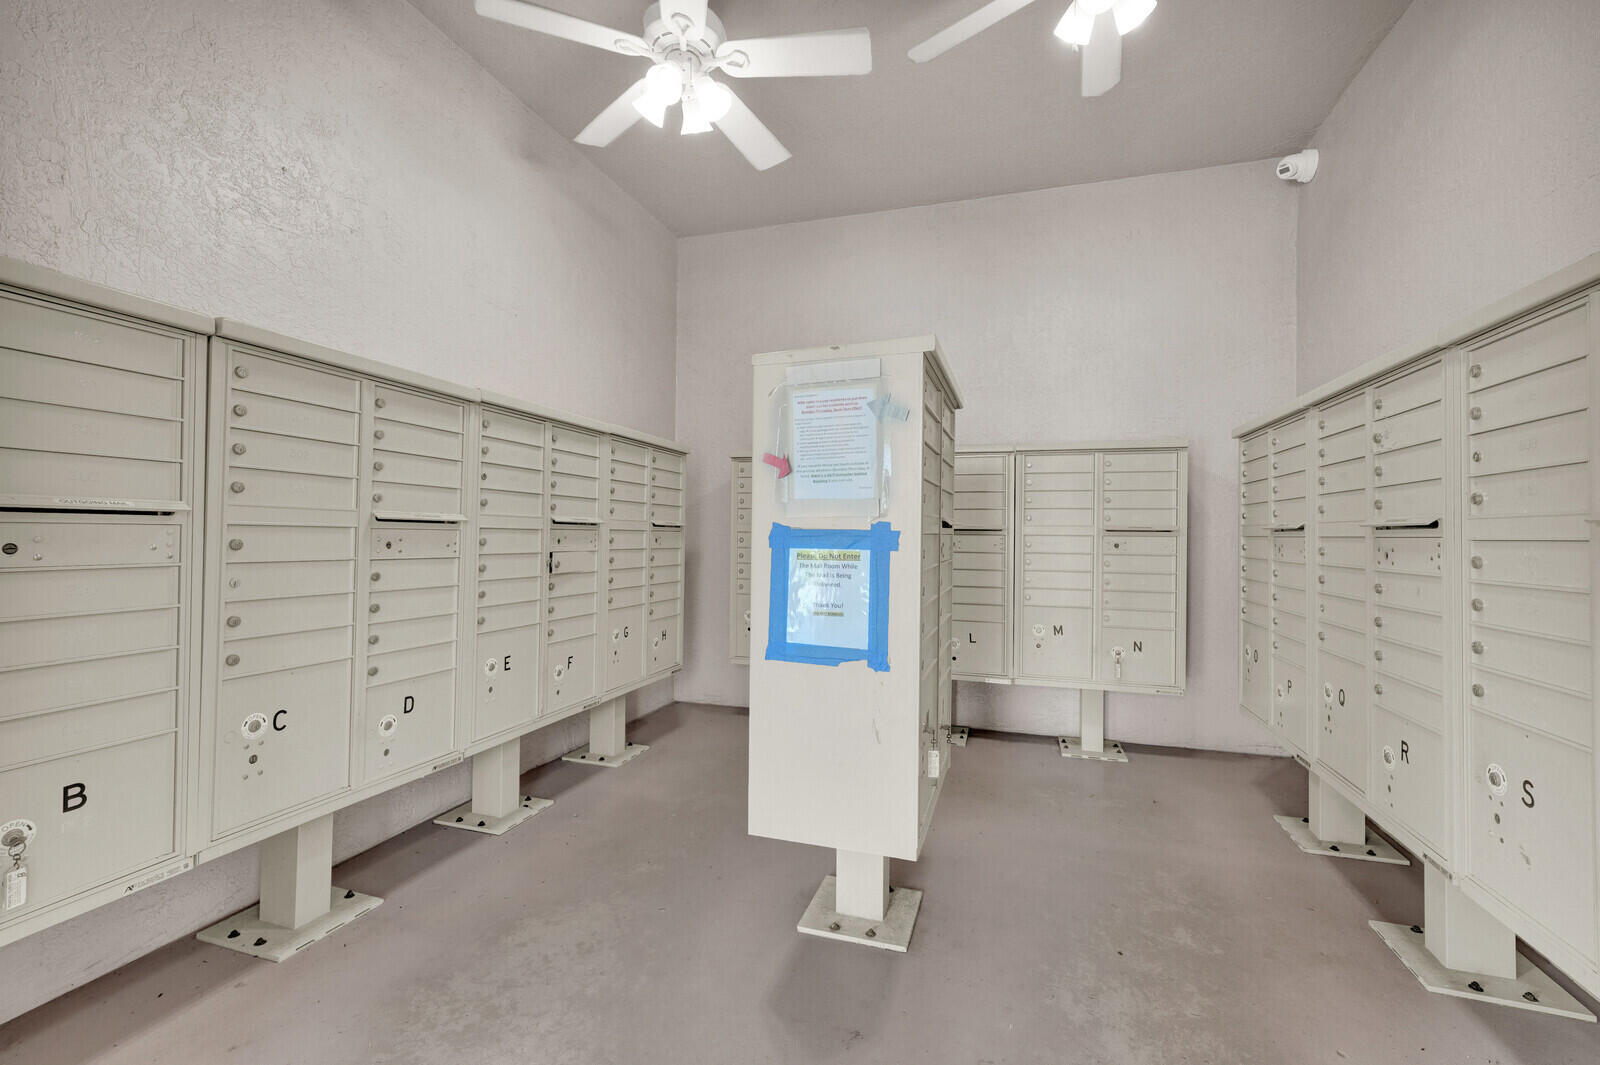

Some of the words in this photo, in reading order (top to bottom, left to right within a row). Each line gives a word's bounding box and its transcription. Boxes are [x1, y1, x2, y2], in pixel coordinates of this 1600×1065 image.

[836, 572, 852, 580] Being
[623, 626, 629, 638] G
[661, 629, 667, 641] H
[969, 632, 977, 644] L
[1053, 625, 1064, 636] M
[1133, 641, 1143, 653] N
[504, 655, 512, 671] E
[567, 656, 574, 670] F
[1287, 679, 1292, 694] P
[403, 696, 415, 714] D
[1338, 688, 1346, 707] Q
[272, 709, 288, 731] C
[1401, 740, 1410, 764] R
[62, 782, 88, 814] B
[1521, 779, 1535, 808] S
